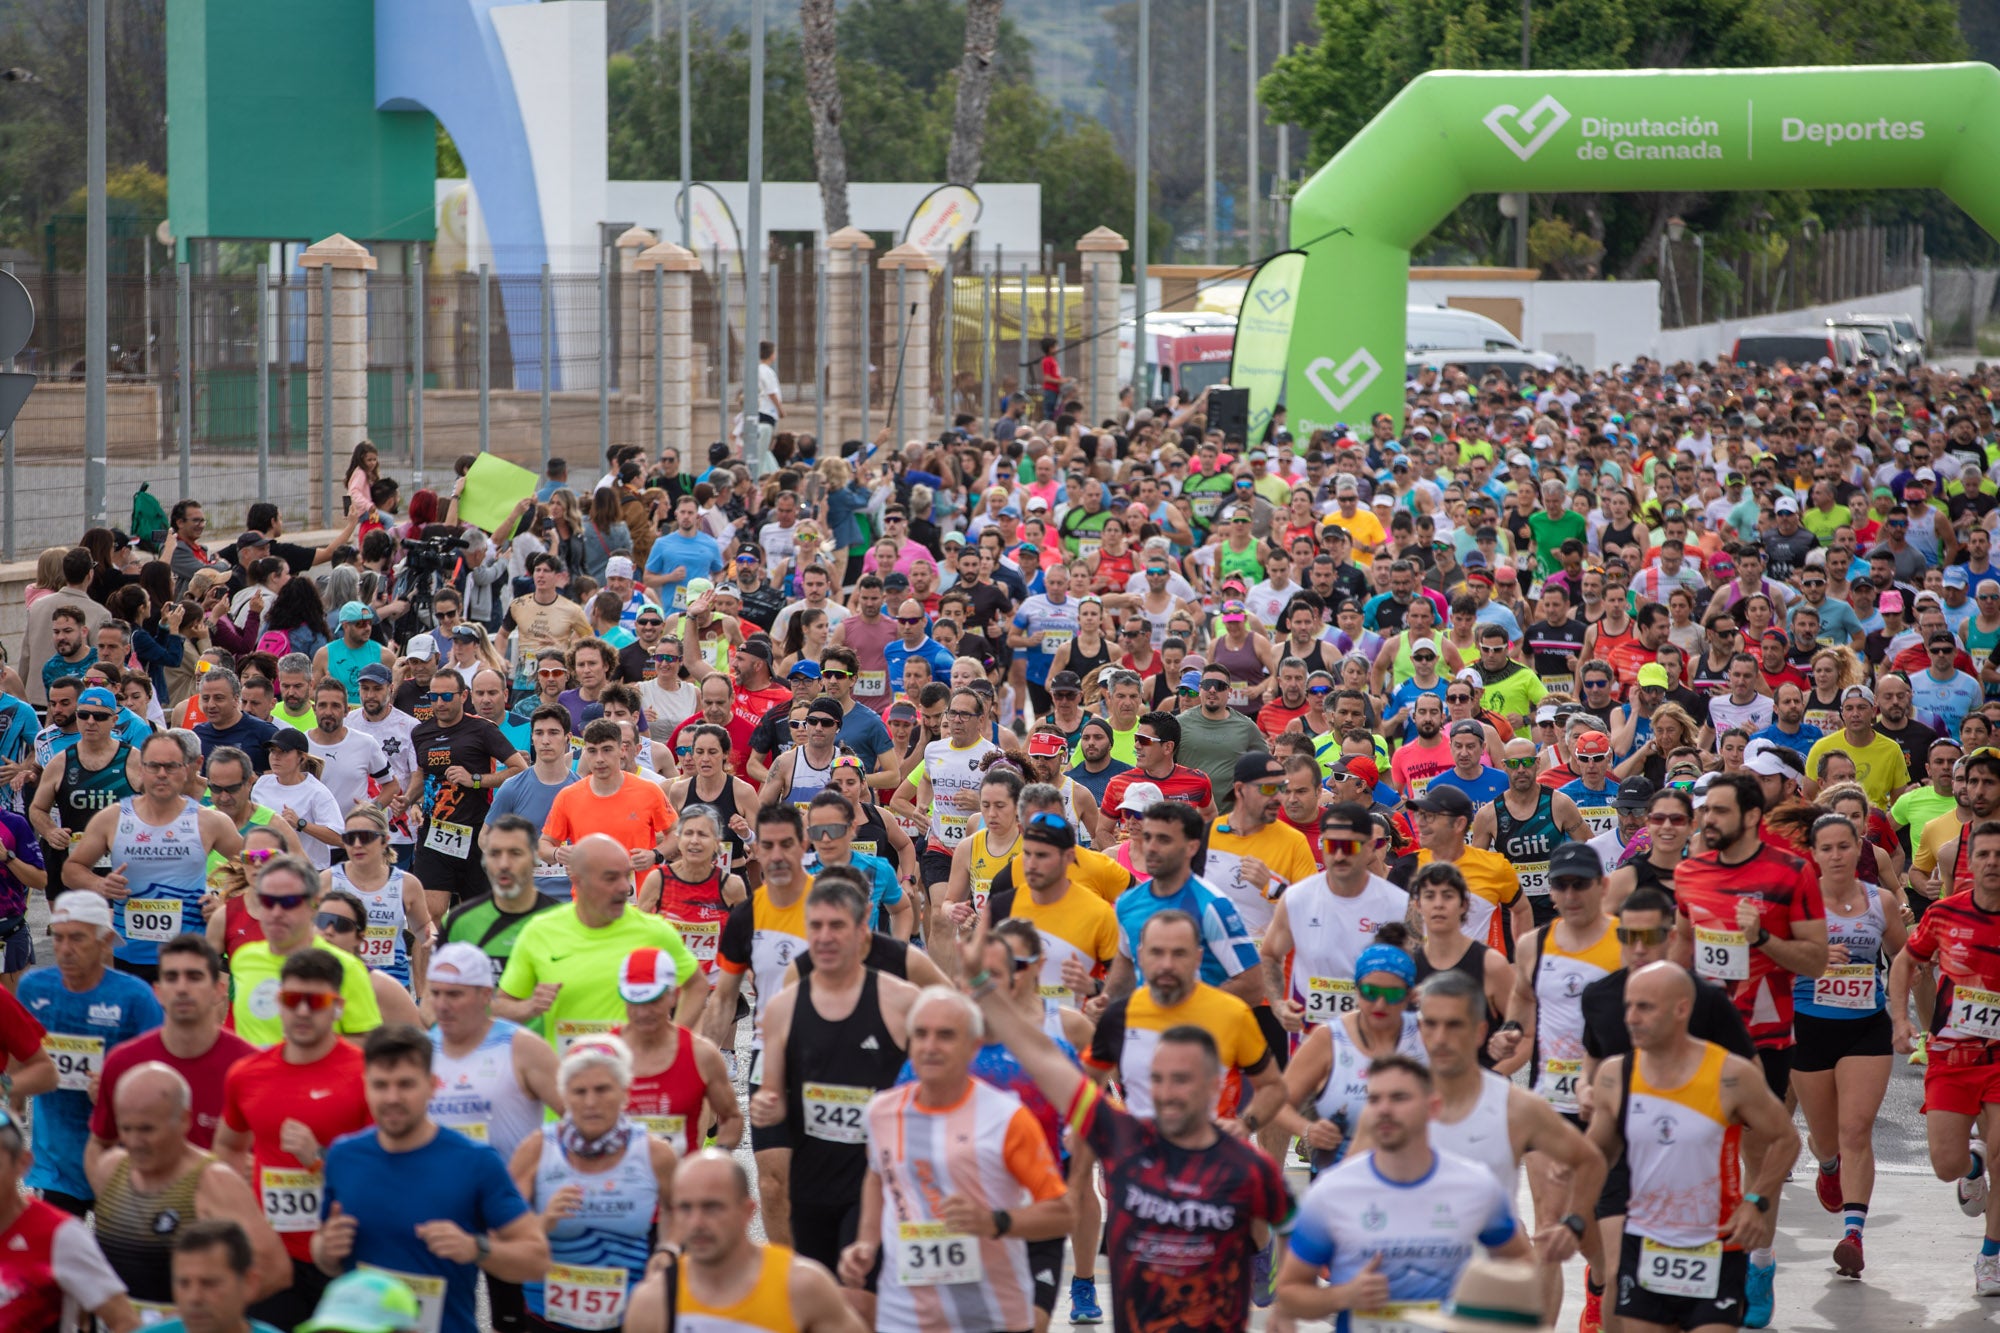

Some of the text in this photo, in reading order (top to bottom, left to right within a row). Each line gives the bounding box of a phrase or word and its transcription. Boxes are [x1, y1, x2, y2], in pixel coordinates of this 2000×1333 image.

[1581, 115, 1719, 142] Diputación
[1781, 116, 1925, 146] Deportes
[1577, 142, 1724, 161] de Granada
[859, 680, 880, 690] 138
[428, 751, 451, 759] FONDO
[428, 758, 452, 767] 2025
[75, 789, 117, 810] Giit
[434, 829, 463, 848] 571
[1507, 836, 1551, 857] Giit
[124, 845, 190, 857] MARACENA
[132, 914, 174, 931] 909
[1828, 936, 1877, 947] ARACENA
[1704, 946, 1729, 966] 39
[1817, 979, 1874, 997] 2057
[1309, 993, 1355, 1012] 318
[48, 1054, 90, 1075] 94
[813, 1104, 862, 1129] 242
[266, 1192, 317, 1215] 330
[1124, 1184, 1236, 1232] PIRATAS
[908, 1243, 965, 1268] 316
[1652, 1256, 1708, 1281] 952
[548, 1284, 621, 1315] 2157
